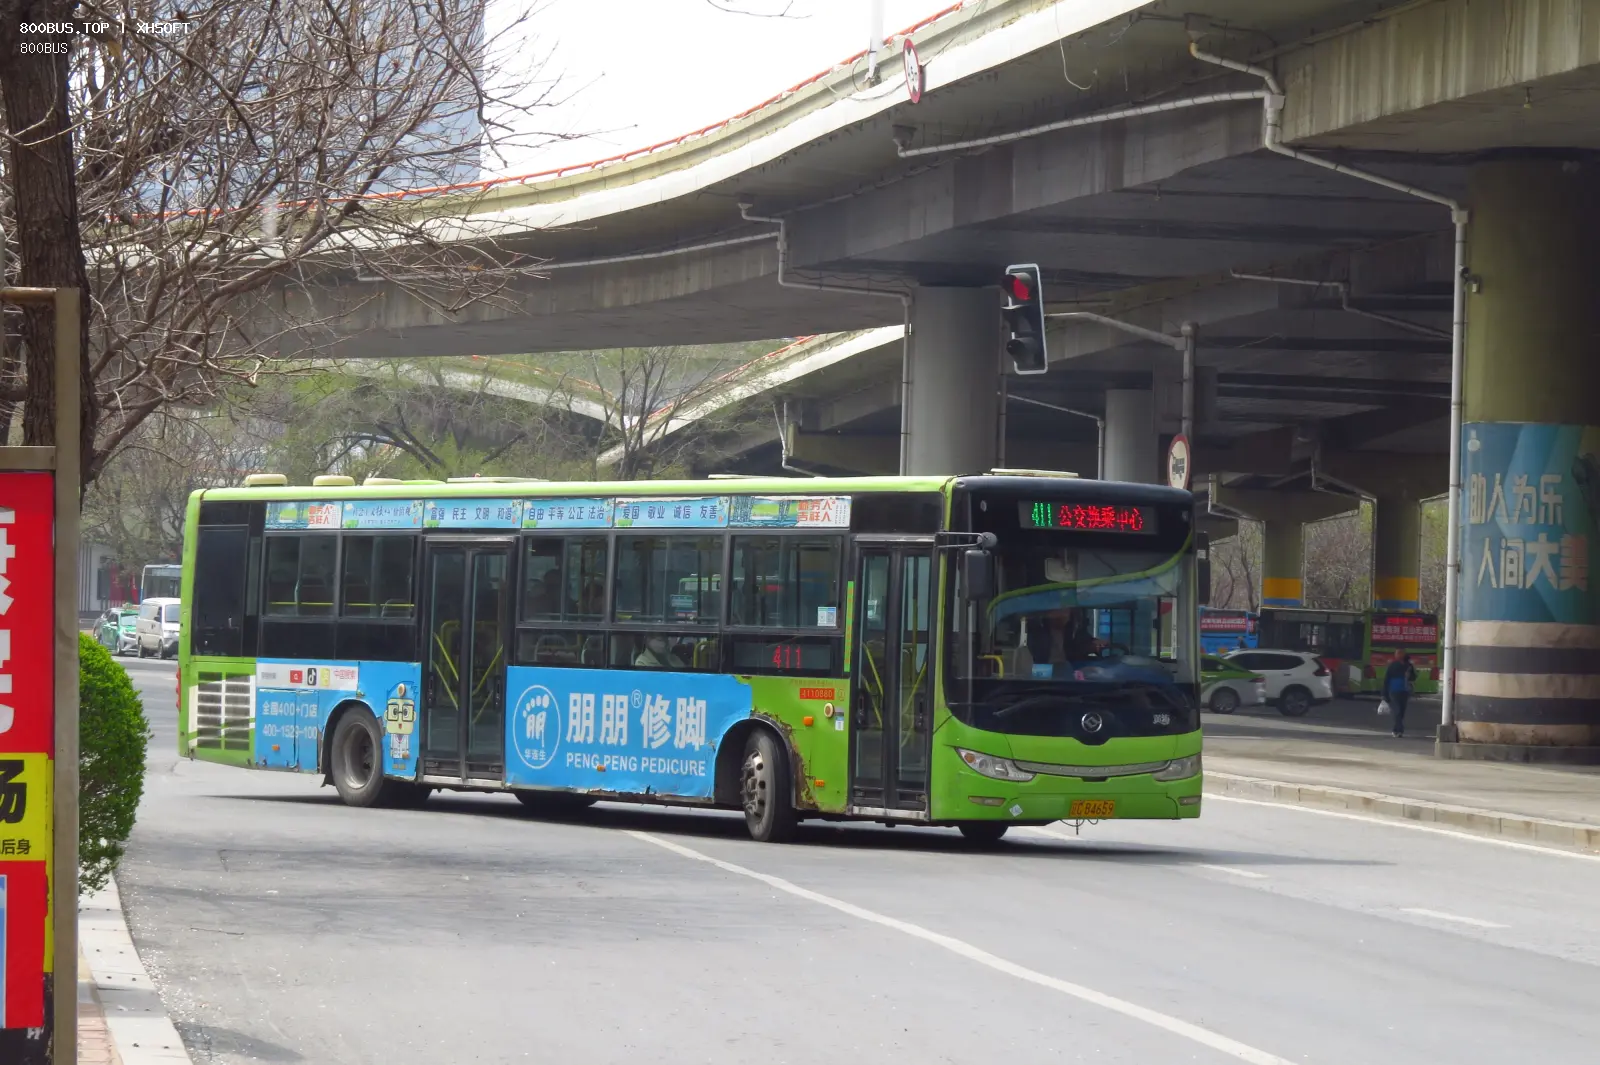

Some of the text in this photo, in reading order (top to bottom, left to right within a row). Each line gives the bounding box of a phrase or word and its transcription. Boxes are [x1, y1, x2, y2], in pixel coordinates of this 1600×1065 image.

[452, 507, 467, 520] 民主
[474, 507, 490, 520] 文明
[528, 506, 605, 520] 自由 平等 公正 法治
[622, 505, 718, 520] 爱国 敬业 诚信 友善
[1032, 502, 1052, 527] 411
[773, 645, 801, 669] 411
[566, 752, 706, 776] PENG PENG PEDICURE
